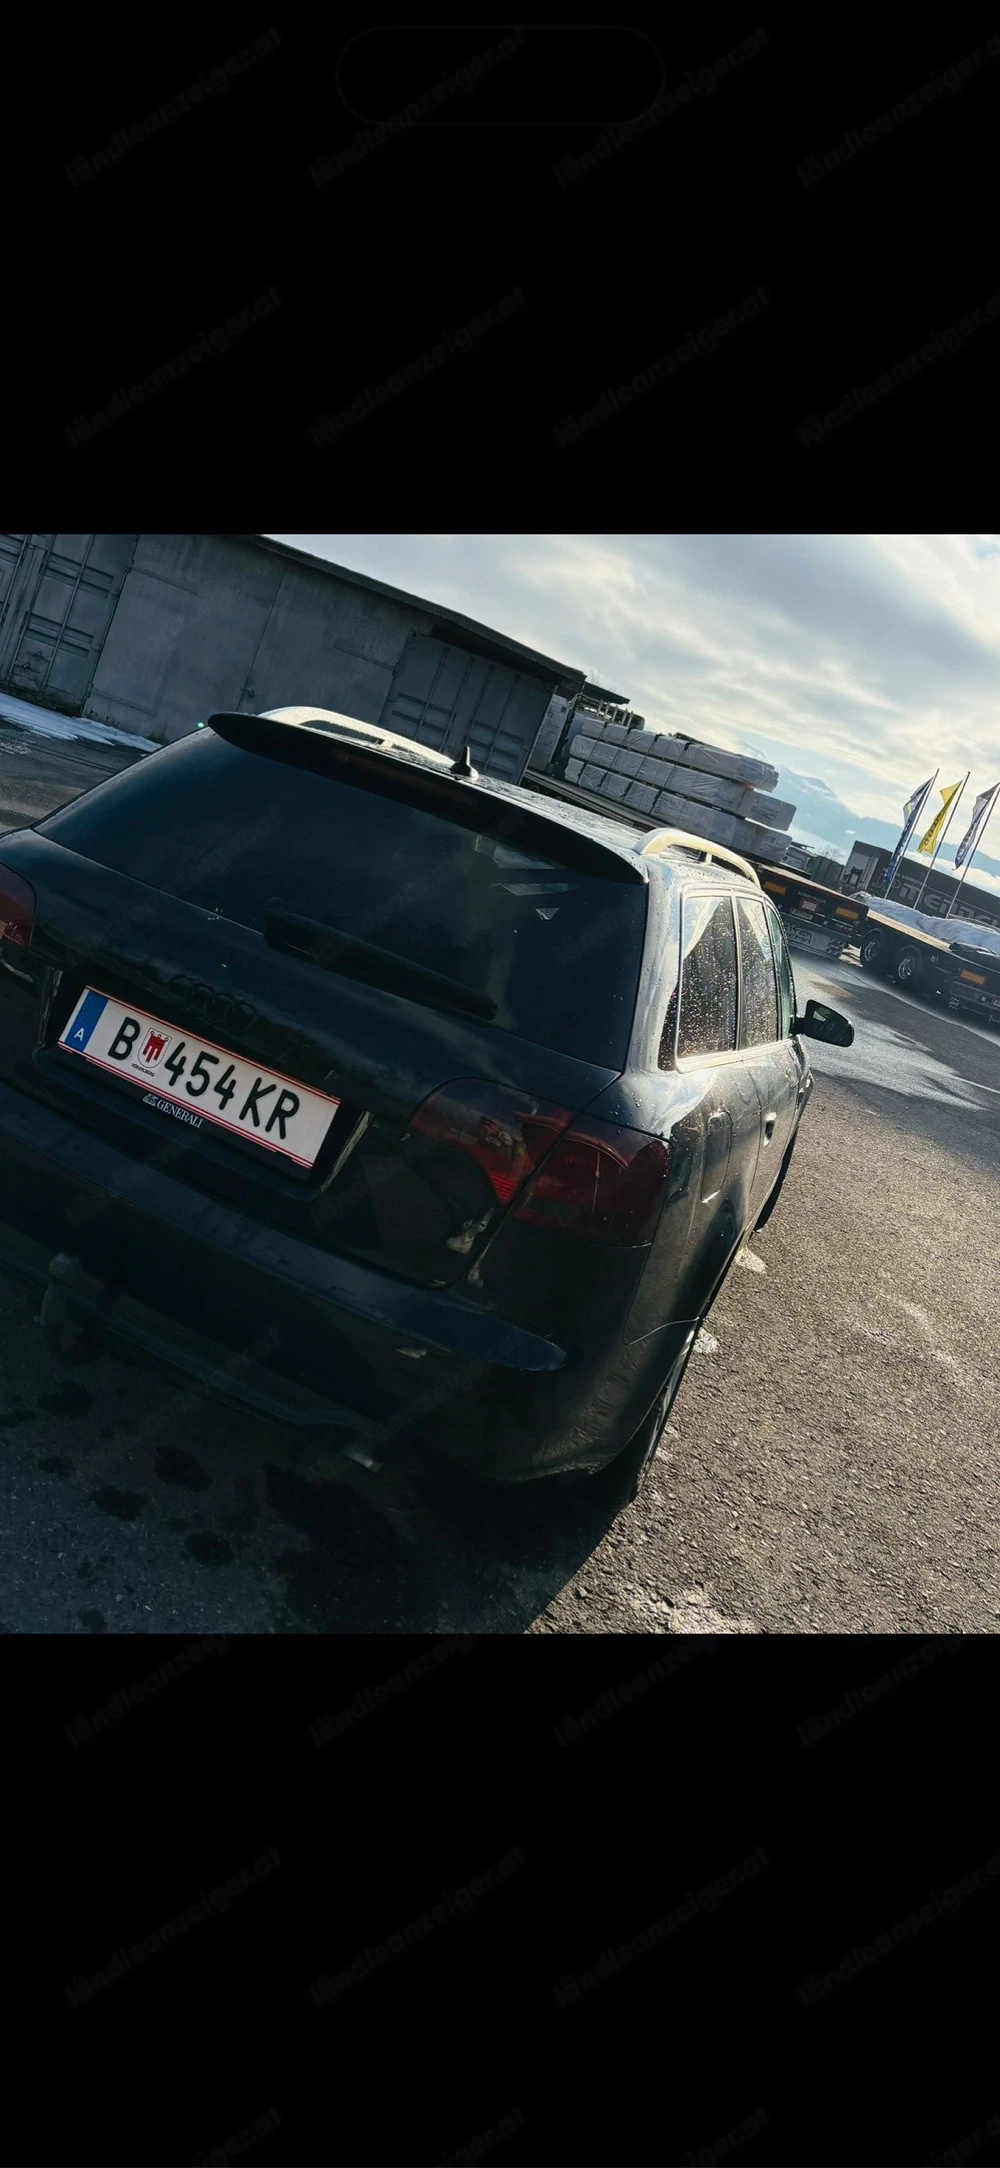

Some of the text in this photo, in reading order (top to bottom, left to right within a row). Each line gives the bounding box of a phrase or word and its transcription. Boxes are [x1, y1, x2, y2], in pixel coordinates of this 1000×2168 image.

[73, 1028, 84, 1041] A
[107, 1016, 140, 1061] B
[156, 1099, 202, 1128] GENERALI
